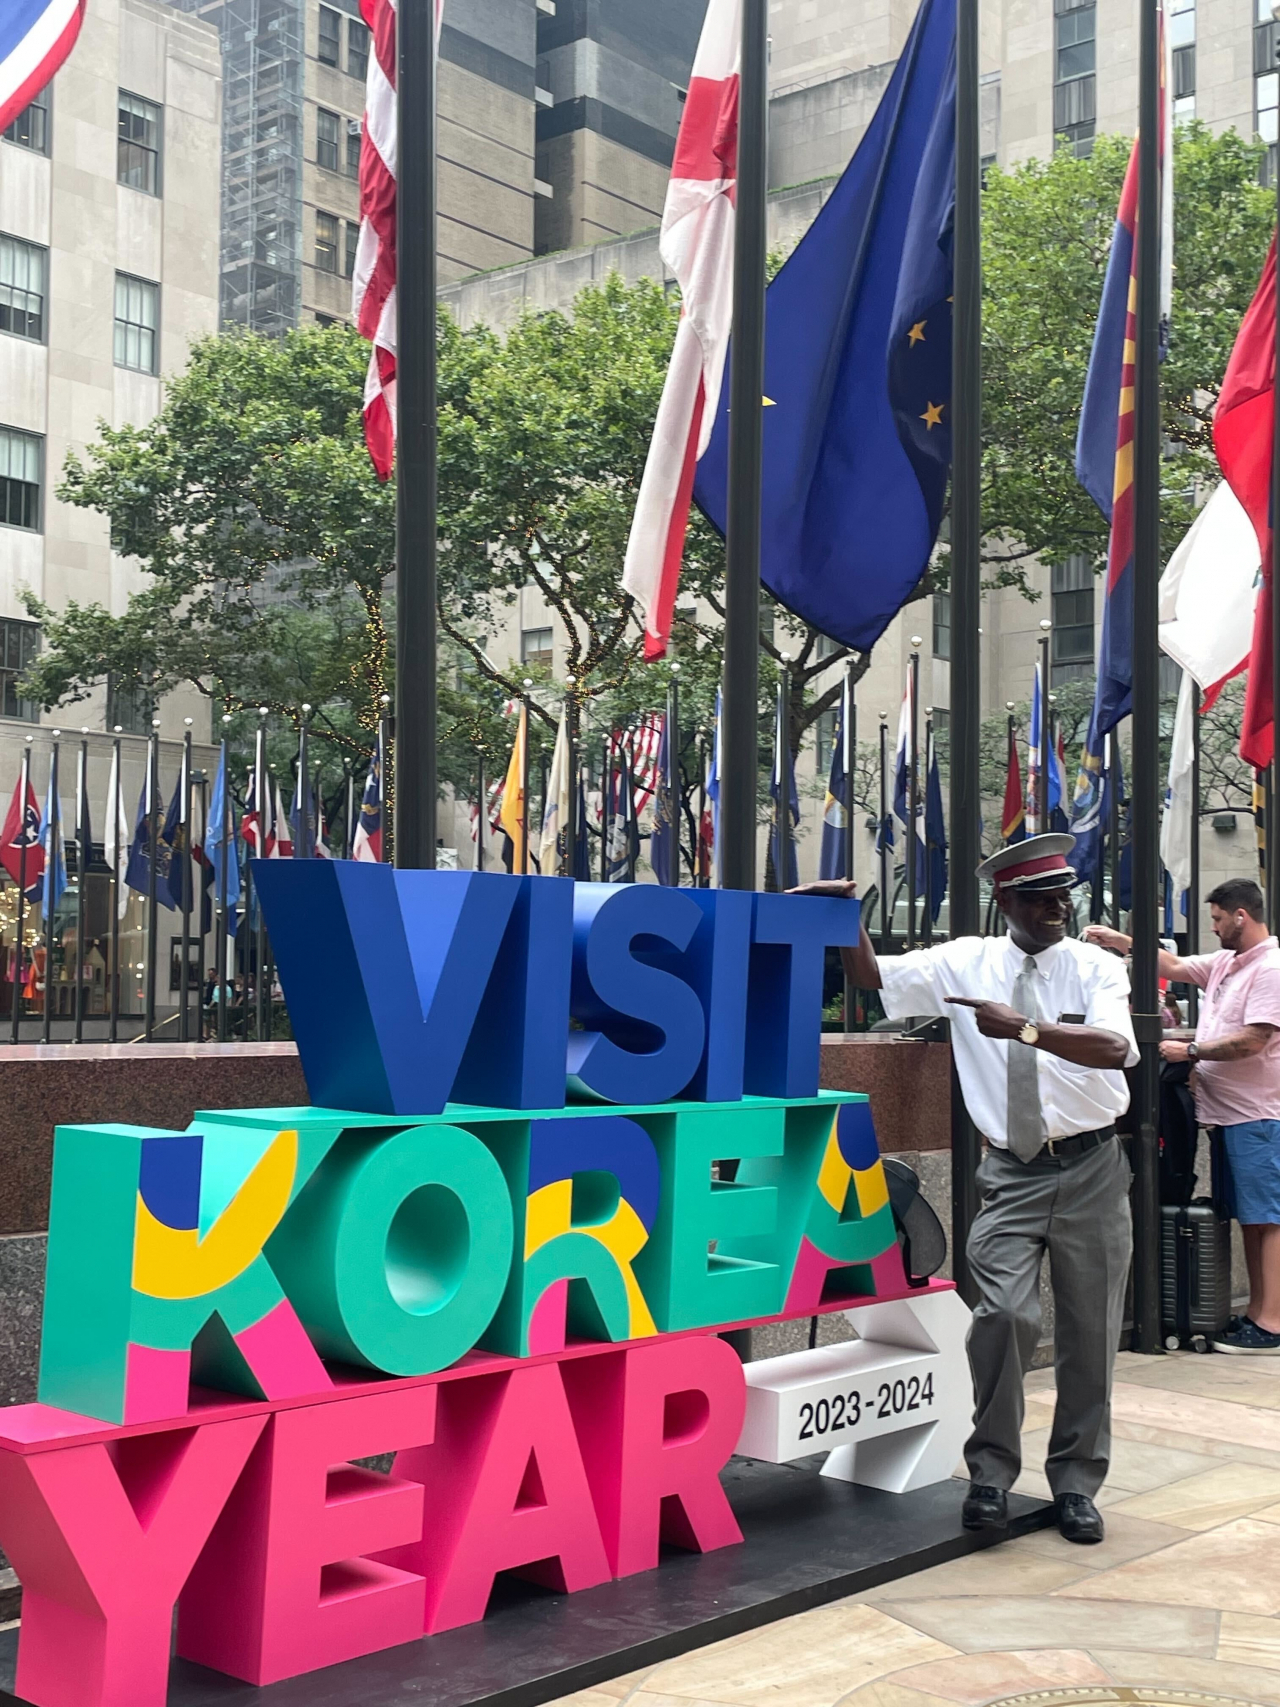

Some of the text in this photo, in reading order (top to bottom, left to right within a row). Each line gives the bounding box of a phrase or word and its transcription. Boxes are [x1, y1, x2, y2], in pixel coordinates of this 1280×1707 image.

[333, 859, 860, 1116] VISIT
[123, 1102, 908, 1426] KOREA
[799, 1372, 935, 1440] 2023-2024
[22, 1335, 745, 1707] YEAR
